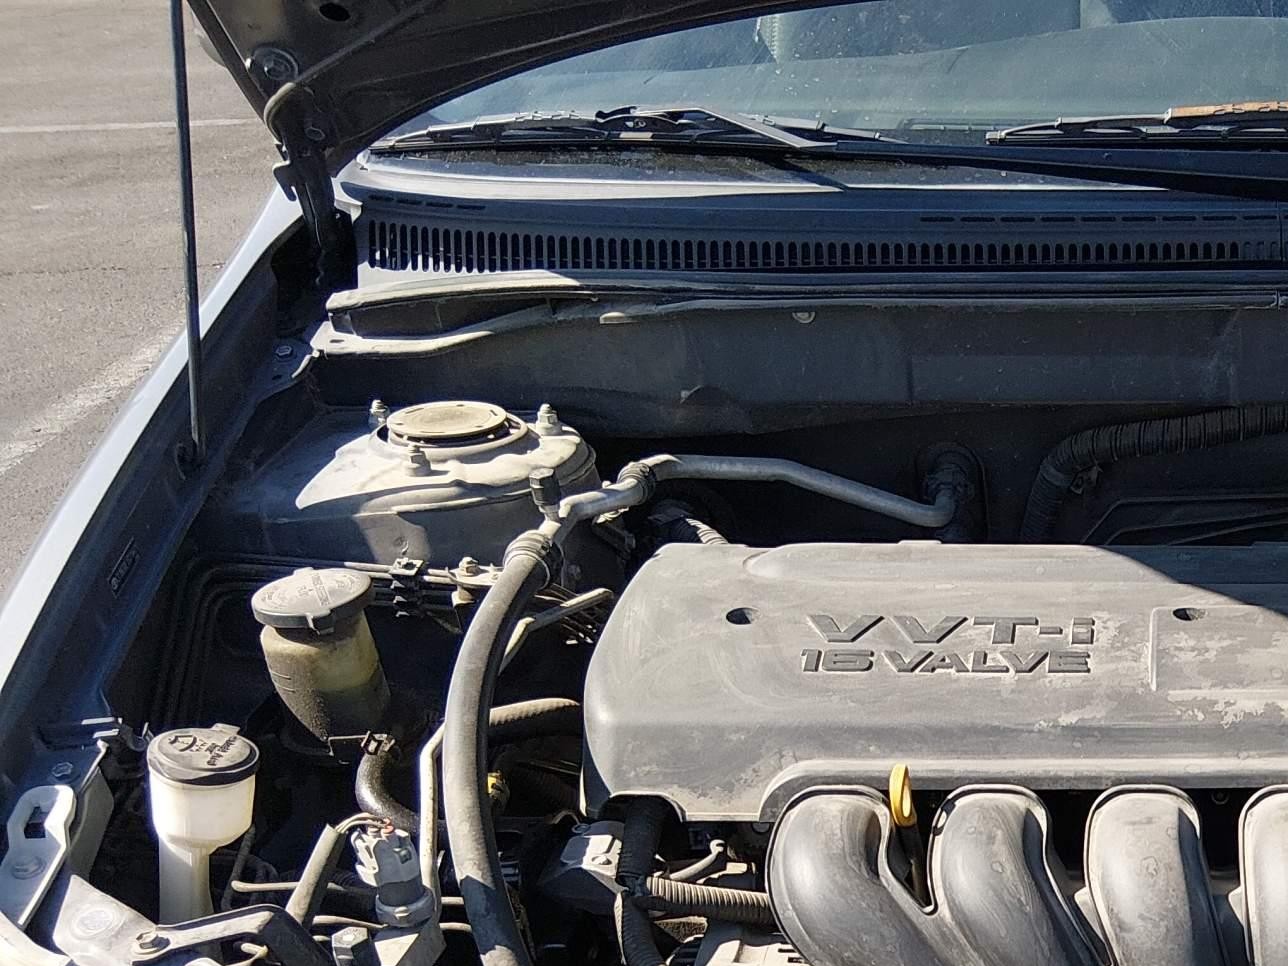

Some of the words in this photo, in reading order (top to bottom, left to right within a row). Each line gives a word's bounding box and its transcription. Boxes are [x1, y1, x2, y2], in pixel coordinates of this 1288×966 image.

[807, 615, 1096, 644] VVT-i
[801, 649, 875, 672] 16
[881, 650, 1091, 674] VALVE
